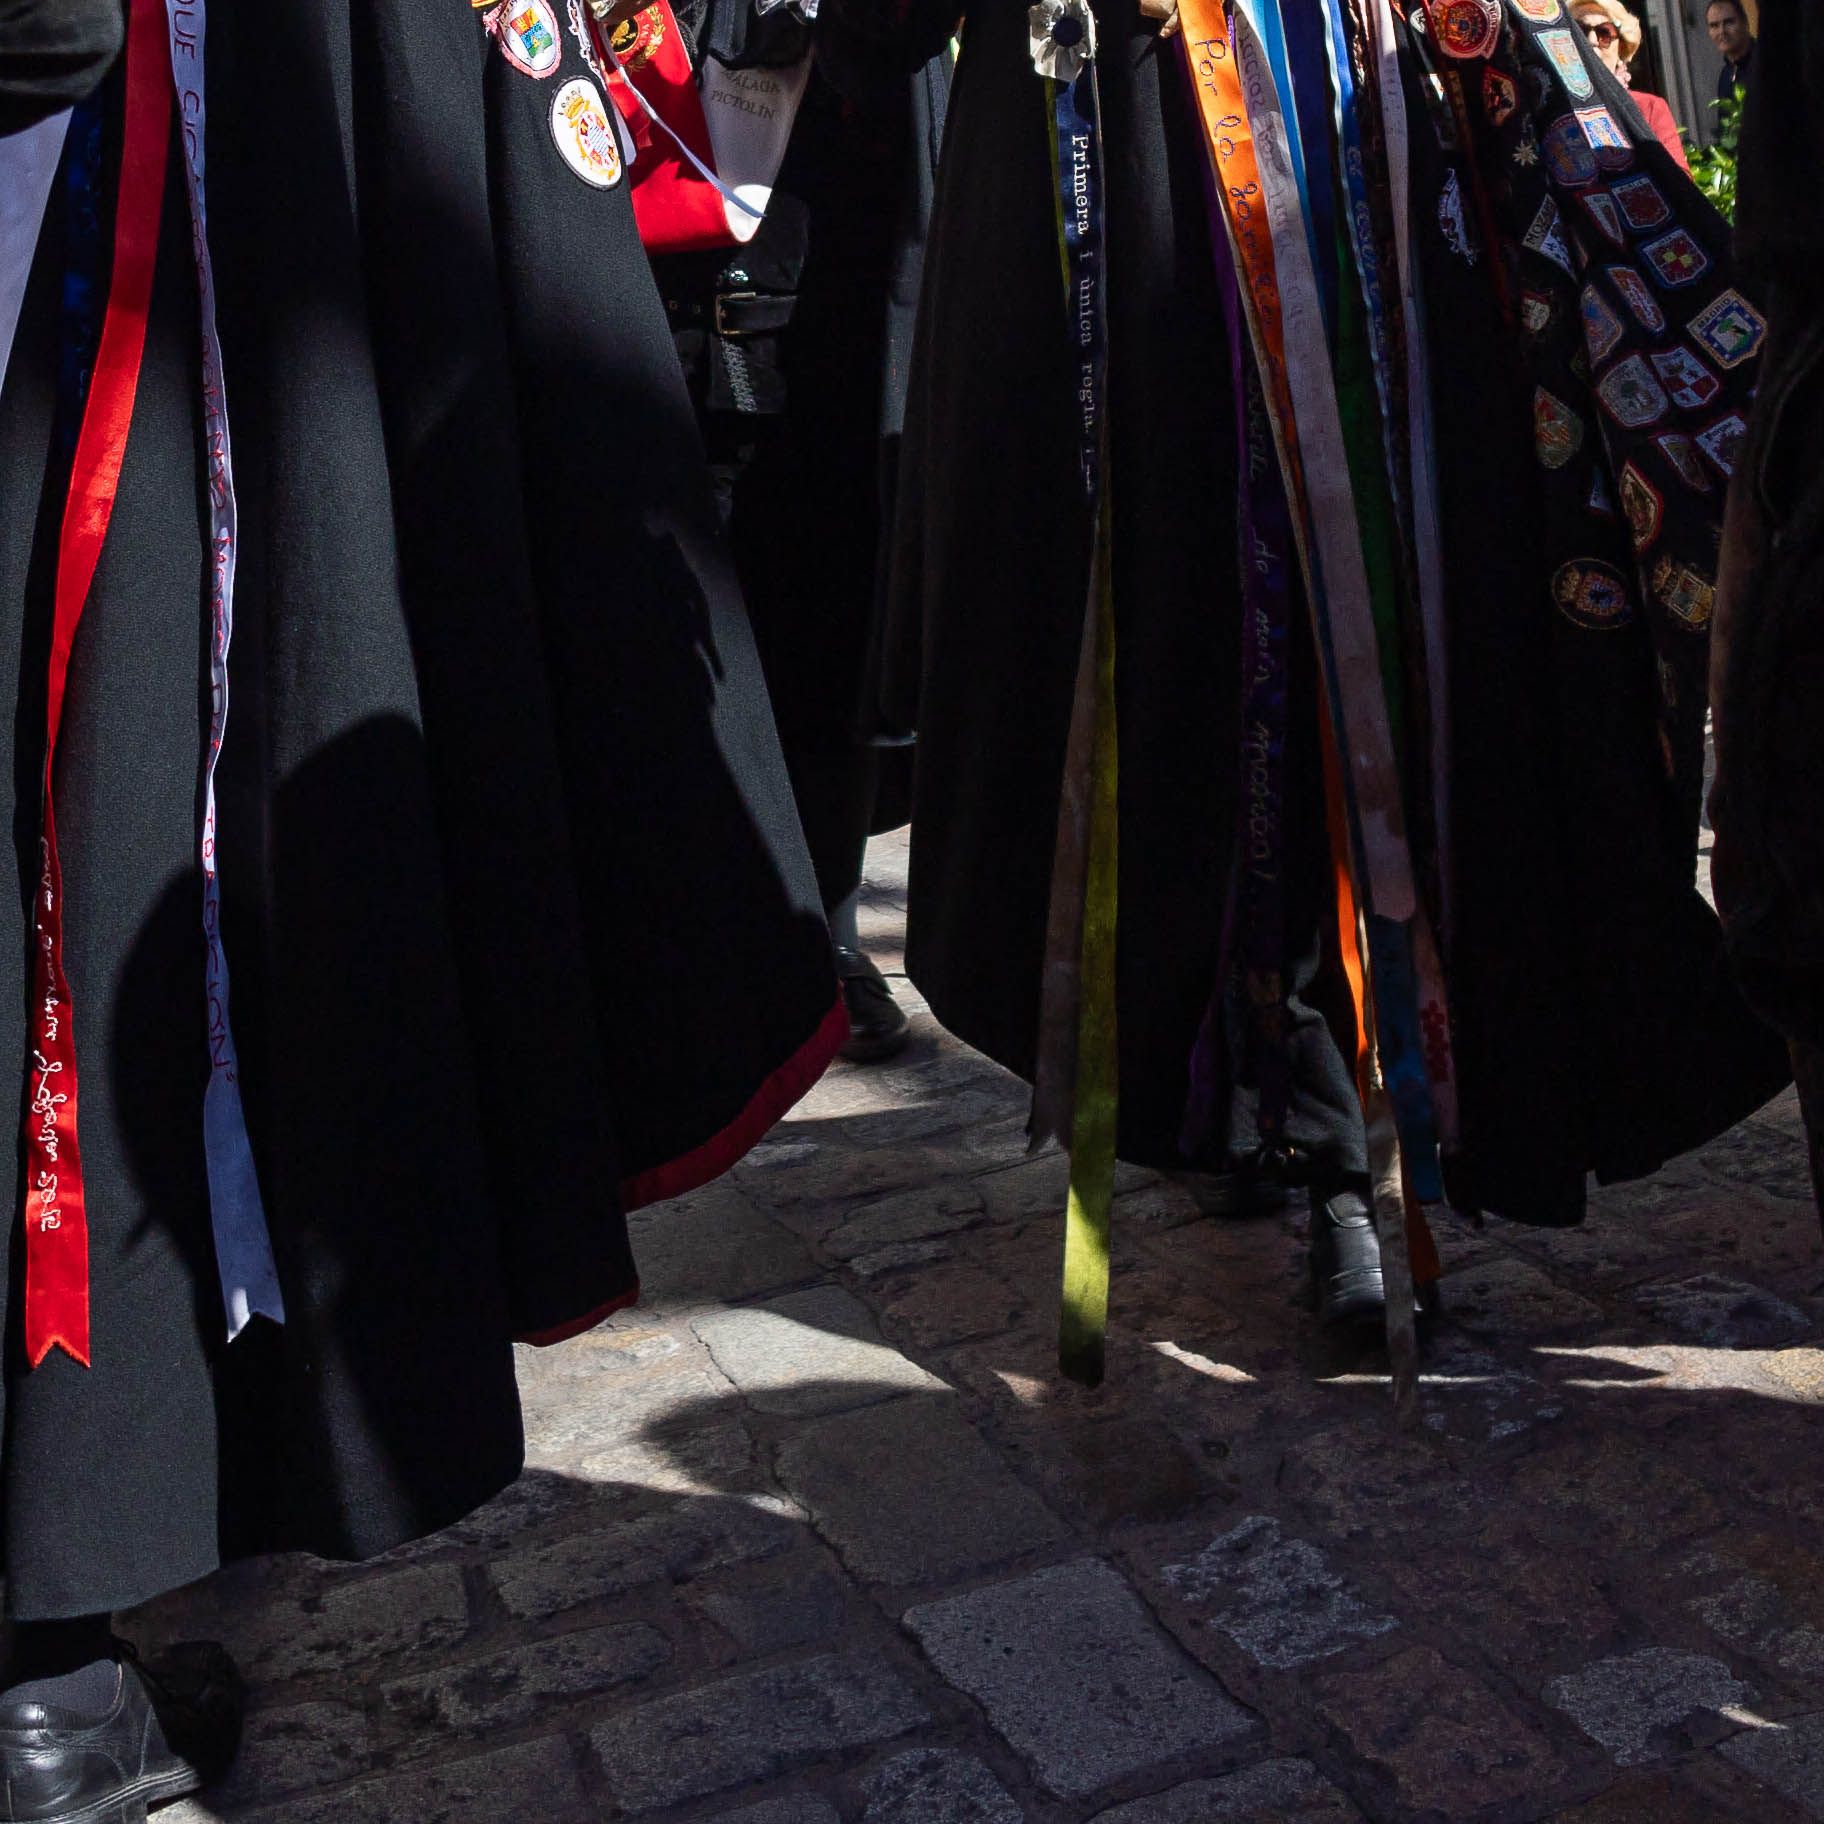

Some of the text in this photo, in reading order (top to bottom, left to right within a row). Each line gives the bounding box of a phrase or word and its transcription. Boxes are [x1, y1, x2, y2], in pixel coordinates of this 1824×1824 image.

[1194, 38, 1226, 96] Por
[1071, 134, 1091, 236] Primera
[1696, 297, 1731, 330] MADRID
